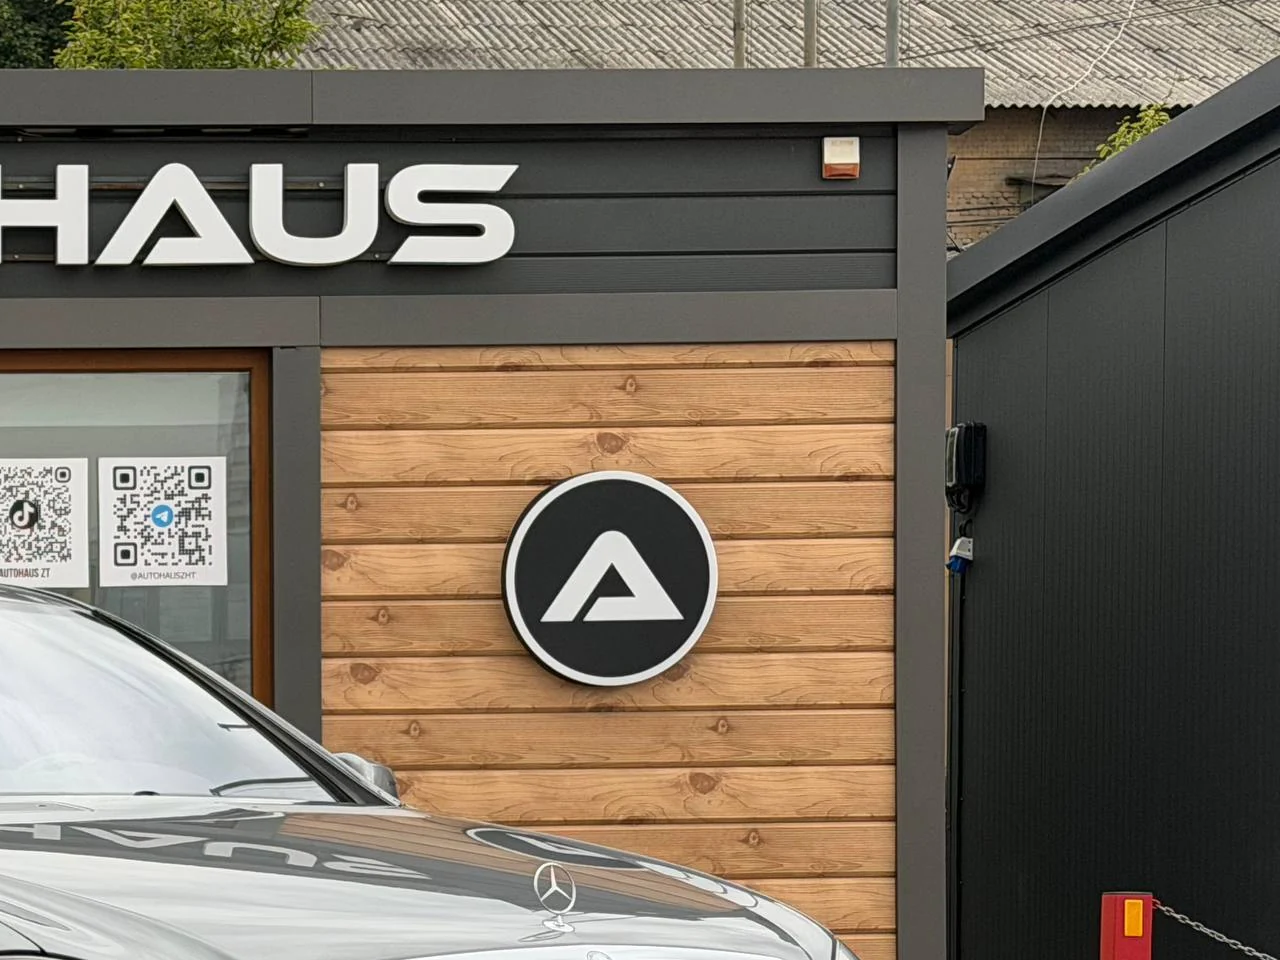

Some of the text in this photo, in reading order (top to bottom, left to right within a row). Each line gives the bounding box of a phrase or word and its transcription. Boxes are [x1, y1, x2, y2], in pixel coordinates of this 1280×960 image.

[41, 567, 51, 577] ZT
[130, 572, 196, 580] @AUTOHAUSZHT
[540, 530, 684, 622] A
